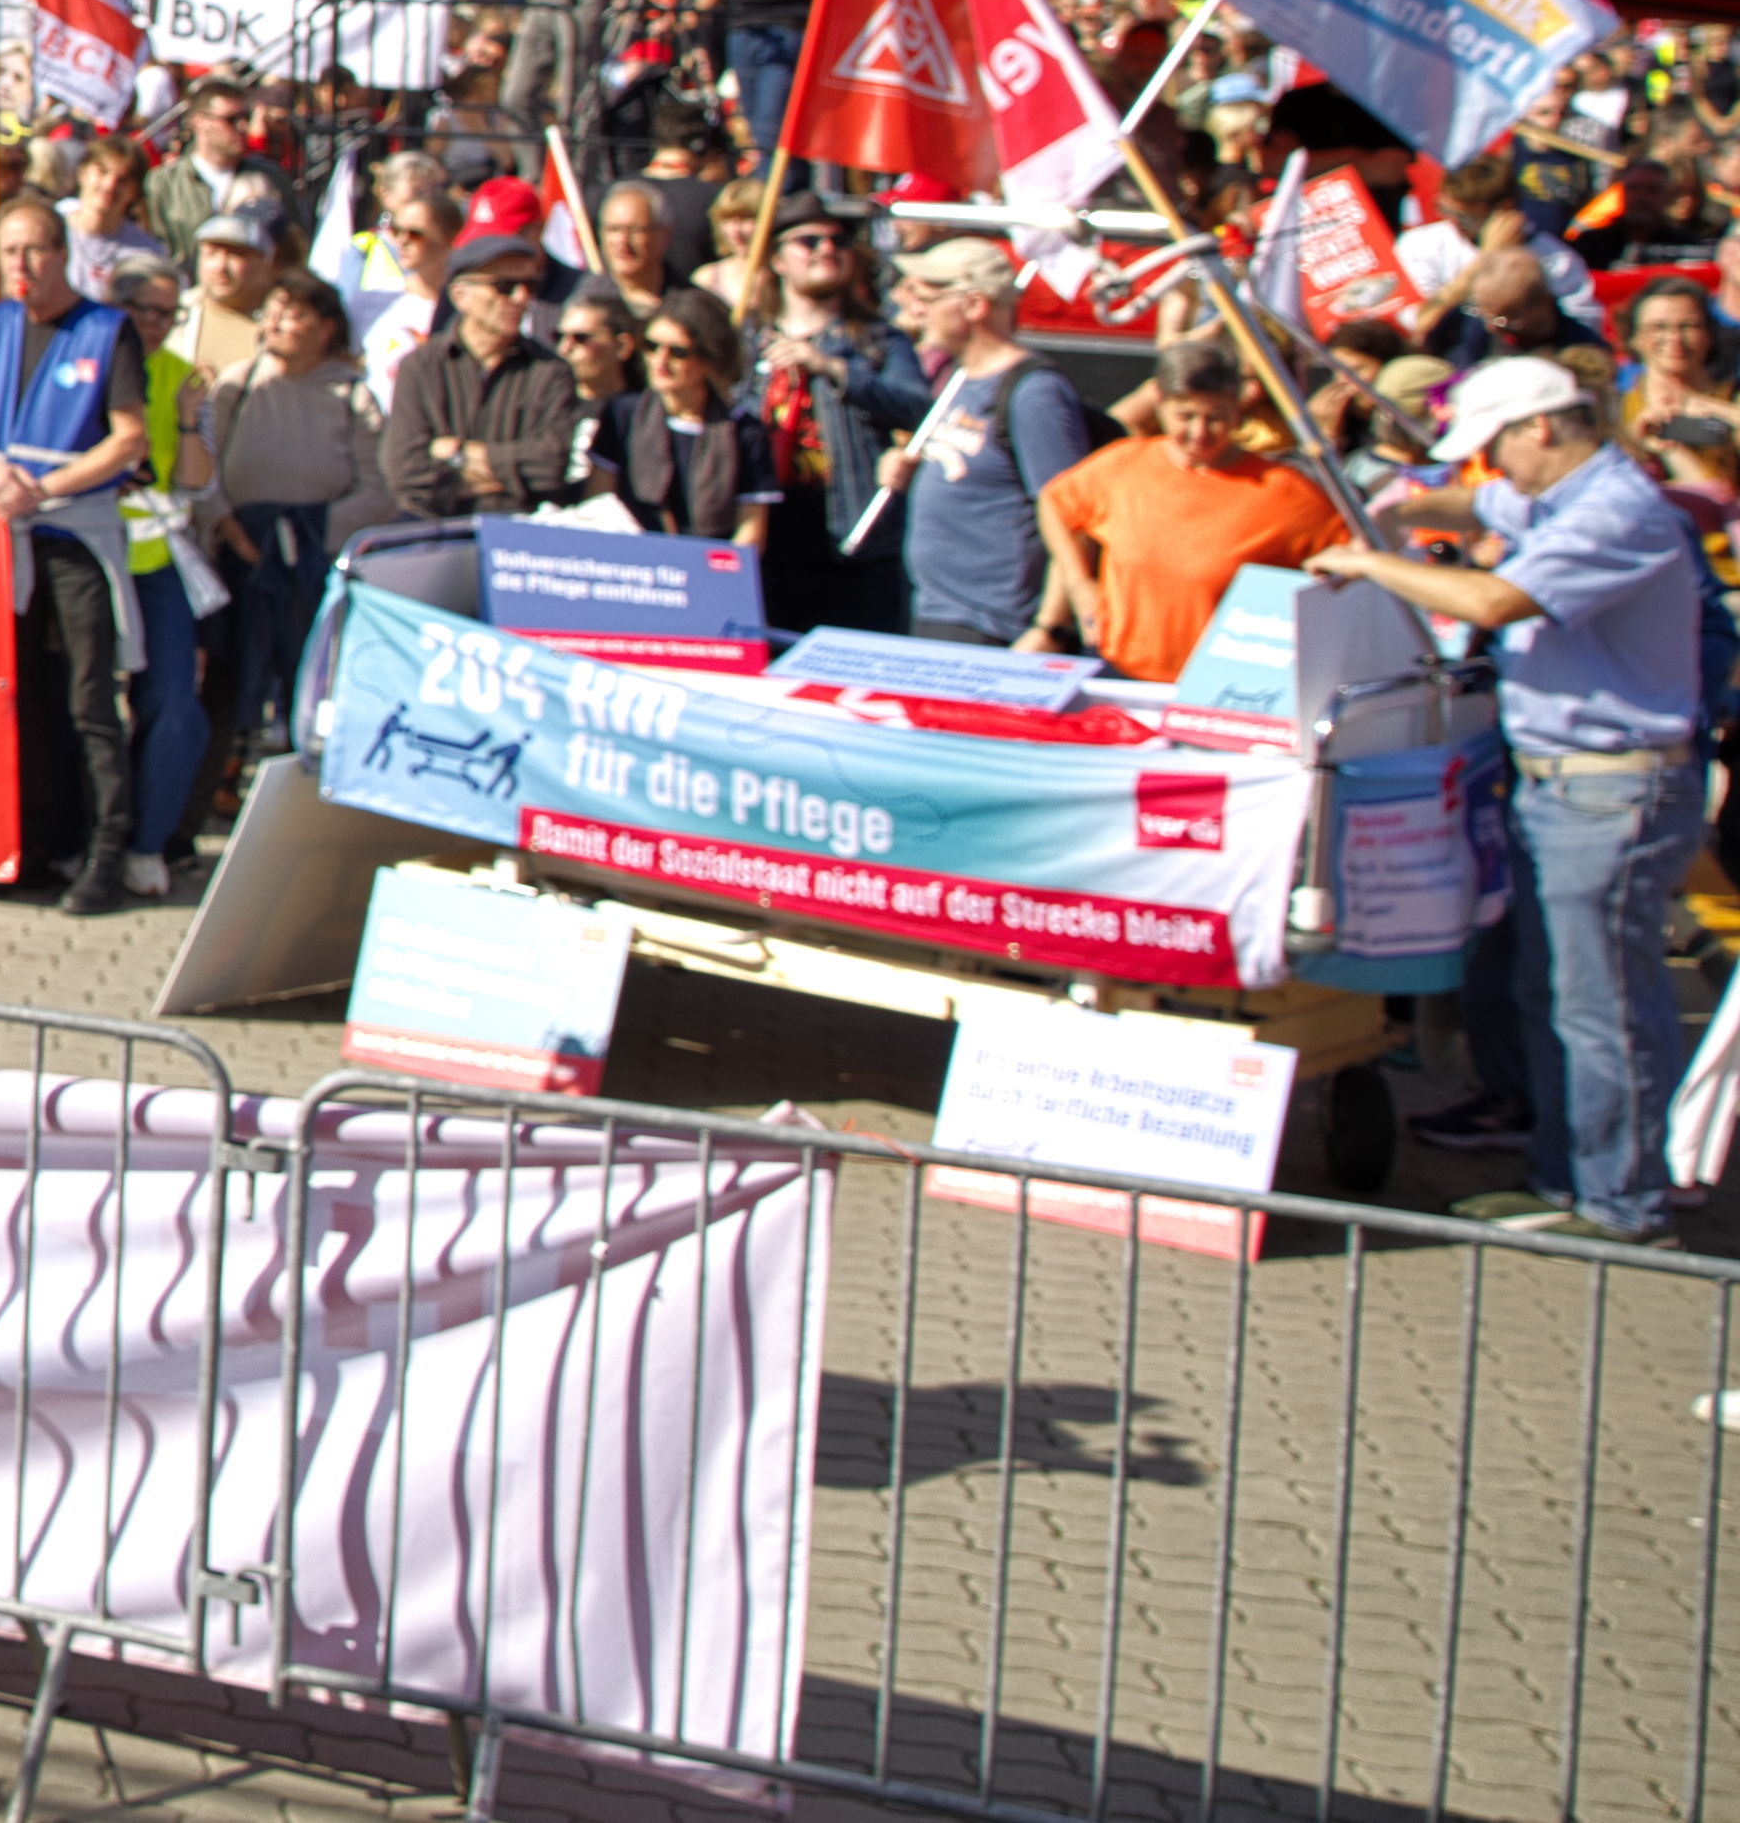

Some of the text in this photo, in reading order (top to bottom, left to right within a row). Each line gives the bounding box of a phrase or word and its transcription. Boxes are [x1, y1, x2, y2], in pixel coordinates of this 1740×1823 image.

[491, 548, 688, 588] Vollversicherung für
[491, 570, 524, 591] die
[526, 573, 590, 601] Pflege
[417, 622, 544, 721] 204
[565, 731, 894, 858] für die Pflege
[532, 814, 1217, 957] Damit der Sozialstaat nicht auf der Strecke bleibt
[1091, 1069, 1237, 1116] Arbeitsplätze
[1139, 1109, 1258, 1159] Bezahlung
